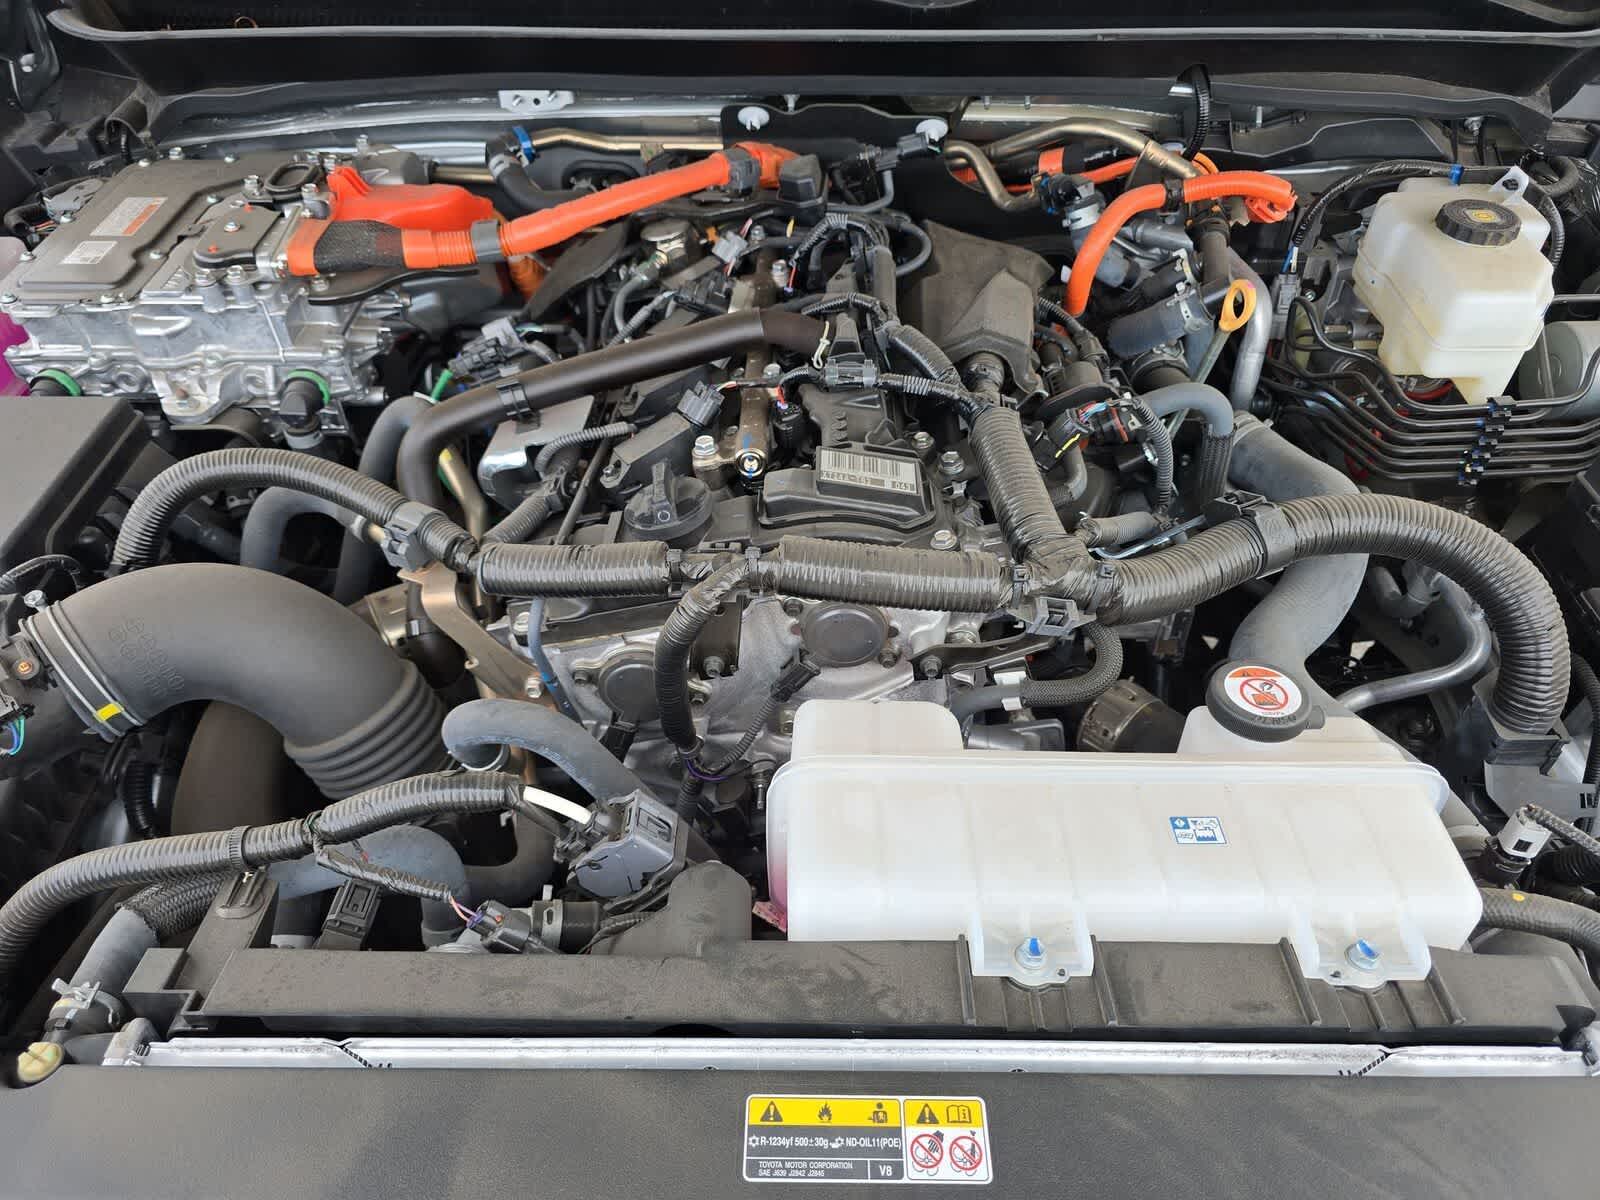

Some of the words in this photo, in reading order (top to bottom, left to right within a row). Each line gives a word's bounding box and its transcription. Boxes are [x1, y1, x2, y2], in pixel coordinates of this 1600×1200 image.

[760, 1136, 793, 1148] R-1234yf
[795, 1136, 829, 1148] 500±30g
[846, 1137, 901, 1149] ND-OIL11(POE)
[759, 1161, 783, 1169] TOYOTA
[785, 1161, 807, 1169] MOTOR
[809, 1161, 853, 1169] CORPORATION
